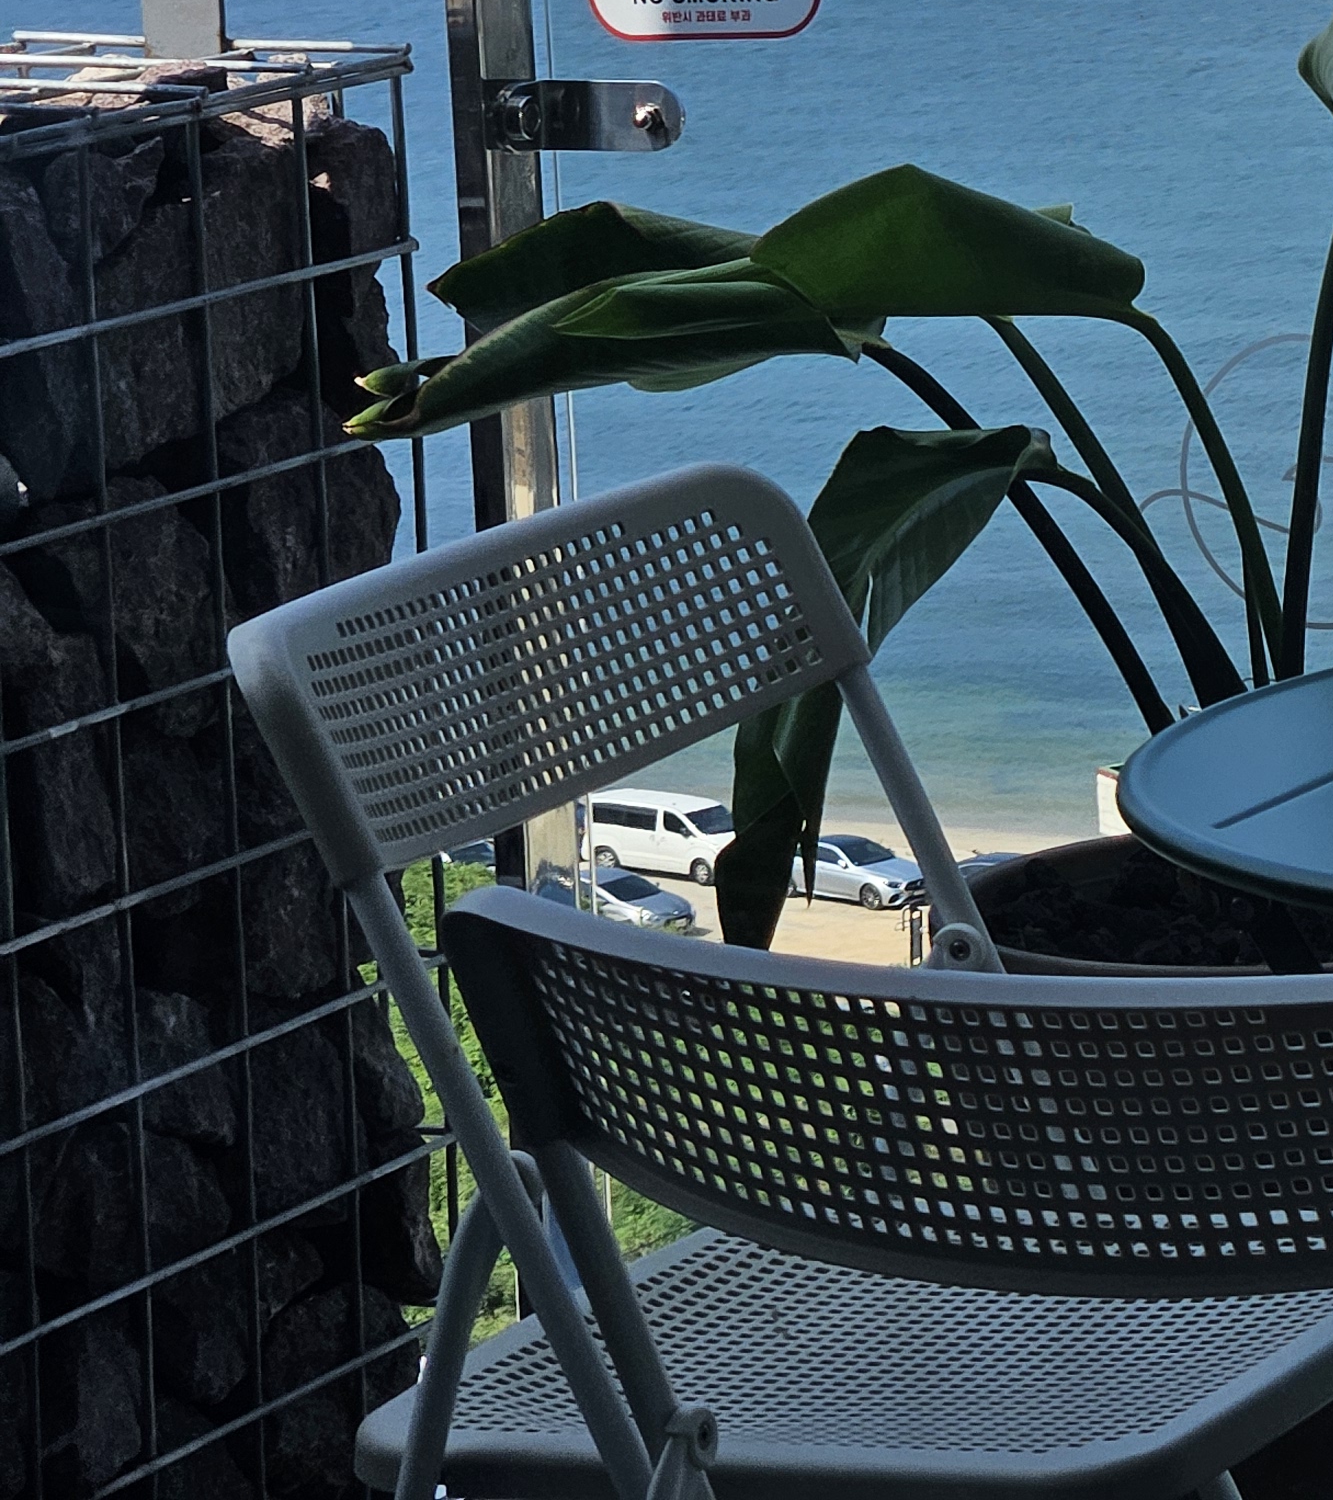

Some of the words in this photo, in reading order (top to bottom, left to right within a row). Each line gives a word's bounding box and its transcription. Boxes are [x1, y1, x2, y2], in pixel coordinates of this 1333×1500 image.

[661, 10, 692, 23] 위반시
[695, 10, 727, 22] 과태료
[730, 9, 752, 22] 부과
